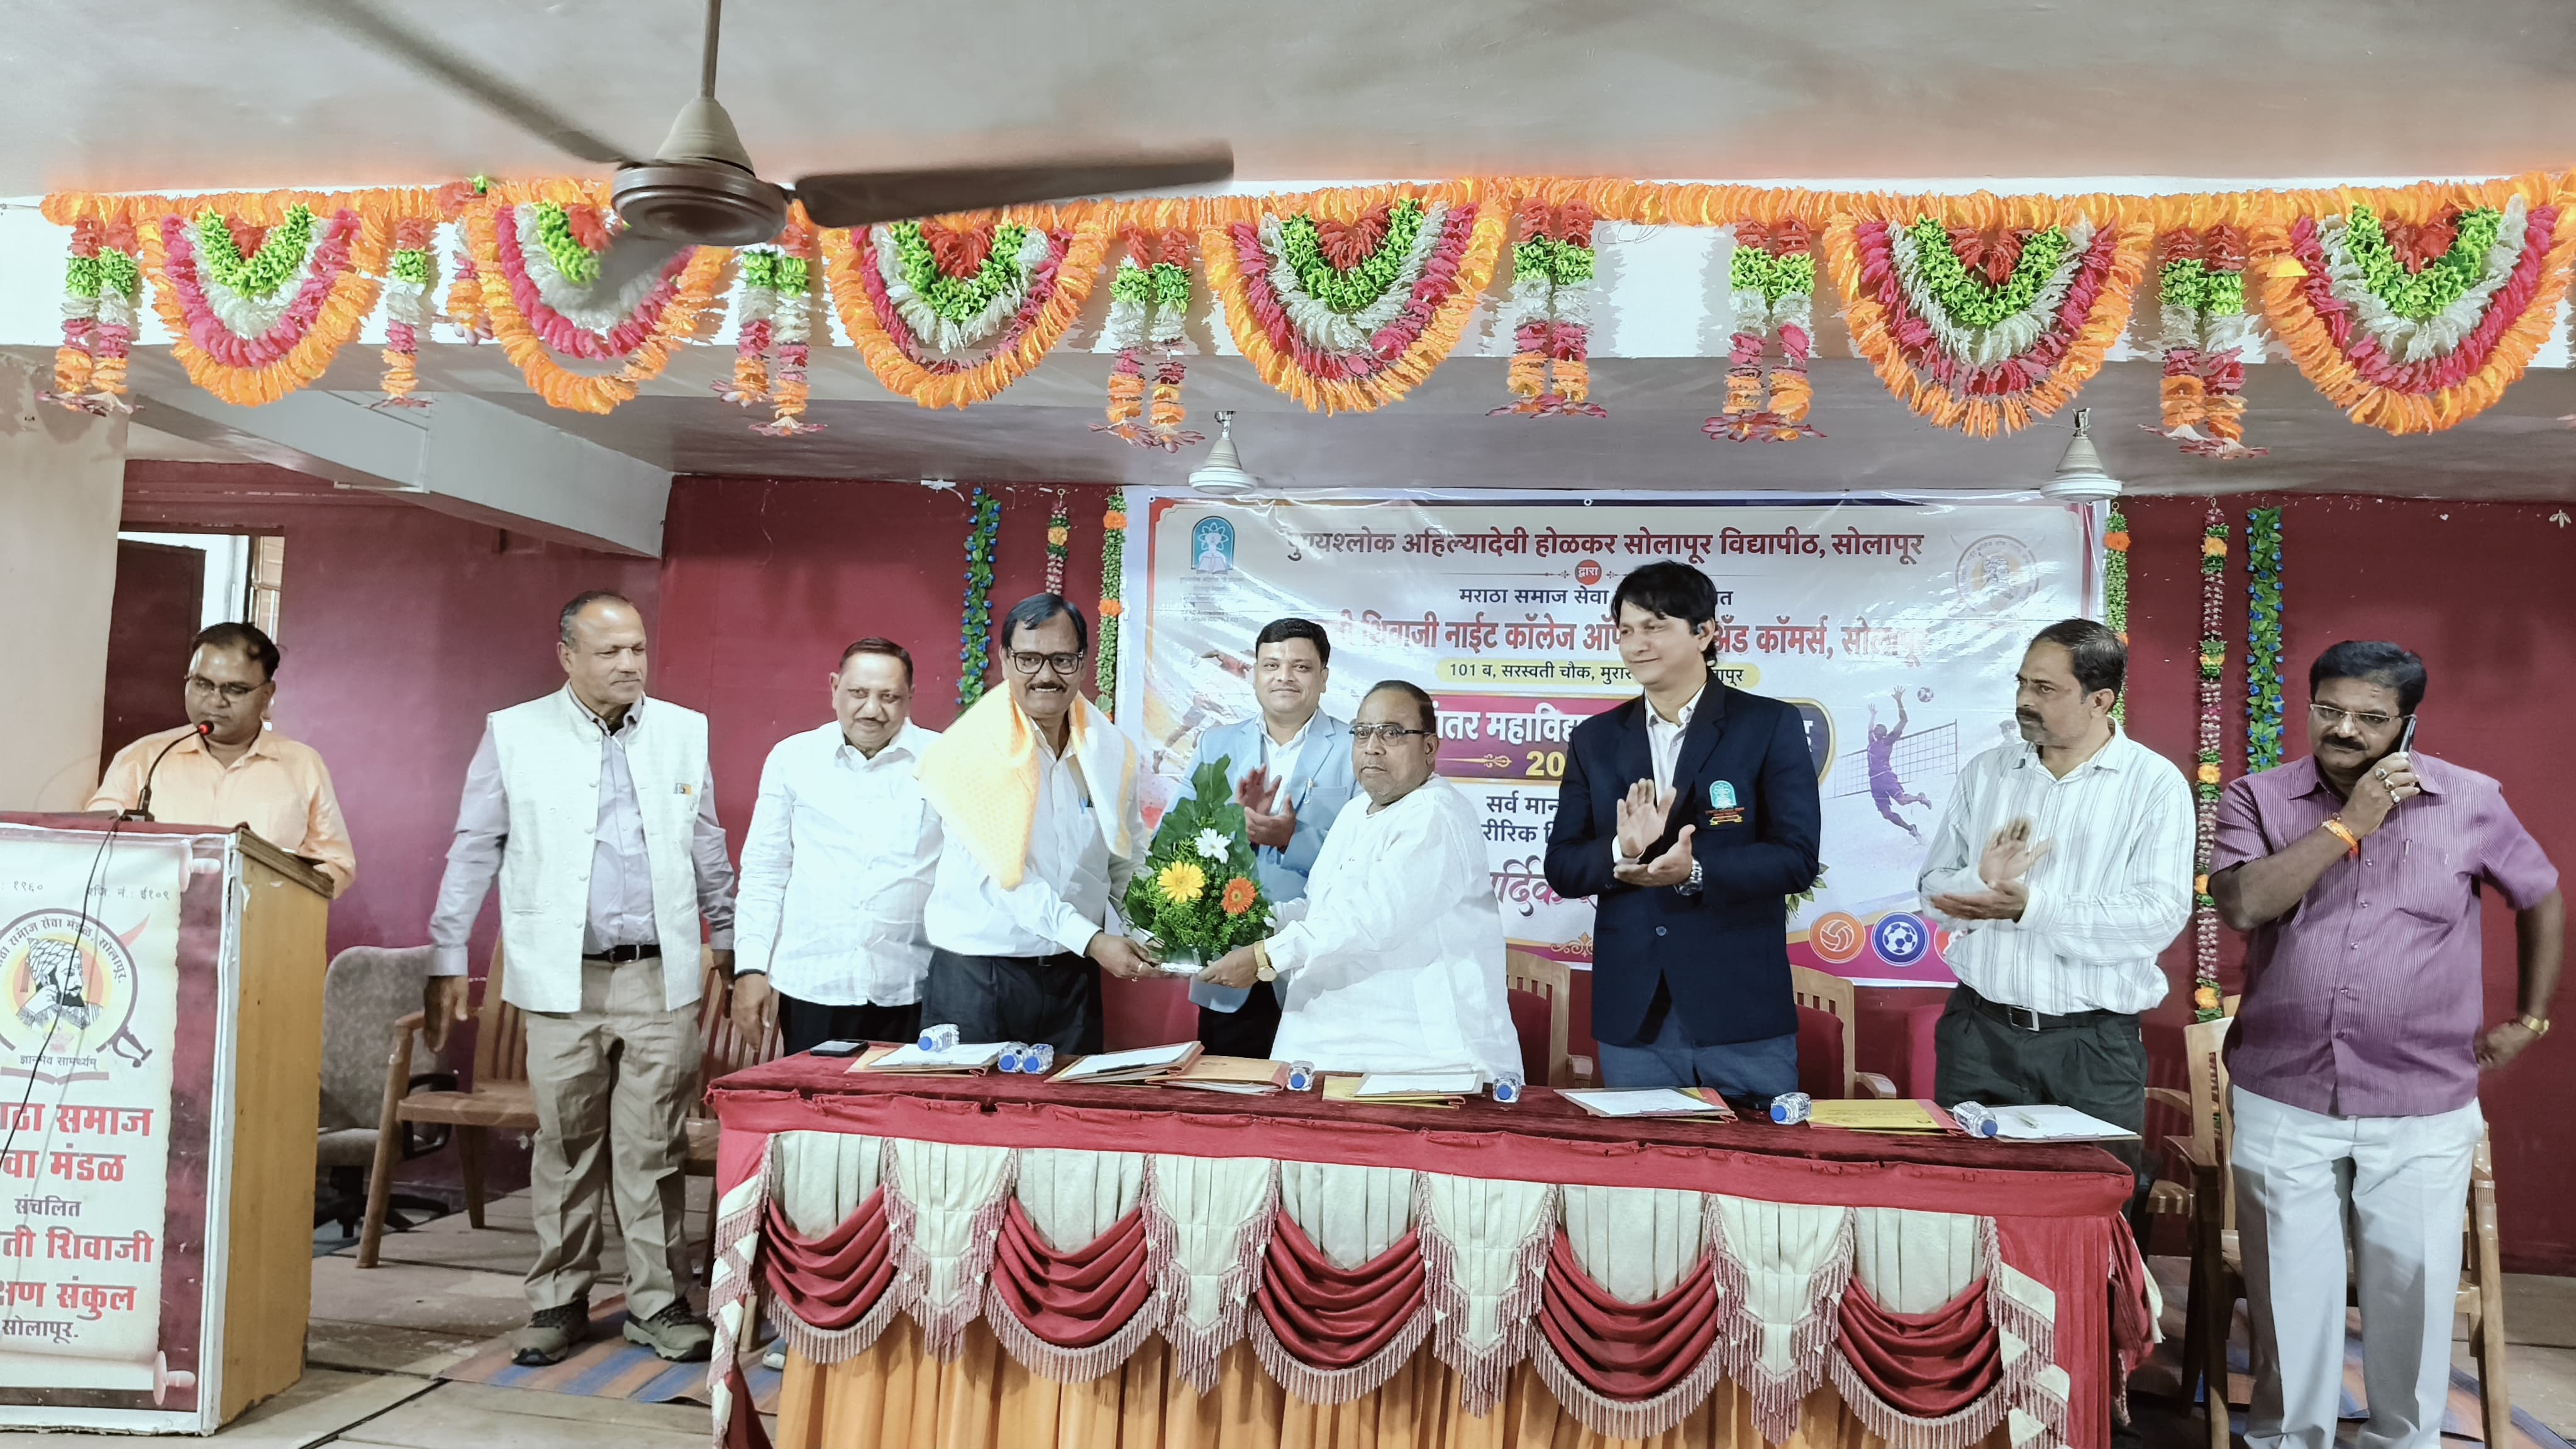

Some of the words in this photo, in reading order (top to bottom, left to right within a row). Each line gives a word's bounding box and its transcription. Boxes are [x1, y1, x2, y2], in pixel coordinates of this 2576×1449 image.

[1402, 526, 1529, 557] अहिल्यादेवी
[1535, 526, 1618, 557] होळकर
[1624, 527, 1713, 564] सोलापूर
[1719, 526, 1825, 558] विद्यापीठ,
[1831, 526, 1924, 565] सोलापूर
[1578, 567, 1599, 577] द्वारा
[1459, 589, 1508, 603] मराठा
[1514, 589, 1568, 604] समाज
[1574, 586, 1609, 604] सेवा
[1362, 609, 1439, 647] शिवाजी
[1445, 611, 1498, 653] नाईट
[1504, 613, 1577, 650] कॉलेज
[1755, 615, 1834, 659] कॉमर्स,
[1450, 664, 1475, 676] 101
[1482, 664, 1496, 678] ब,
[1502, 661, 1555, 678] सरस्वती
[1559, 661, 1595, 680] चौक,
[1600, 667, 1631, 684] मुरार
[1525, 751, 1565, 777] 20
[1486, 790, 1519, 813] सर्व
[1524, 797, 1560, 814] मान
[1481, 818, 1538, 842] रीरिक
[40, 916, 62, 929] सेवा
[57, 1104, 153, 1136] समाज
[0, 1150, 39, 1178] वा
[50, 1143, 126, 1181] मंडळ
[14, 1194, 82, 1216] संचलित
[0, 1224, 36, 1258] ती
[45, 1226, 154, 1262] शिवाजी
[56, 1275, 137, 1321] संकुल
[2, 1315, 79, 1343] सोलापूर.
